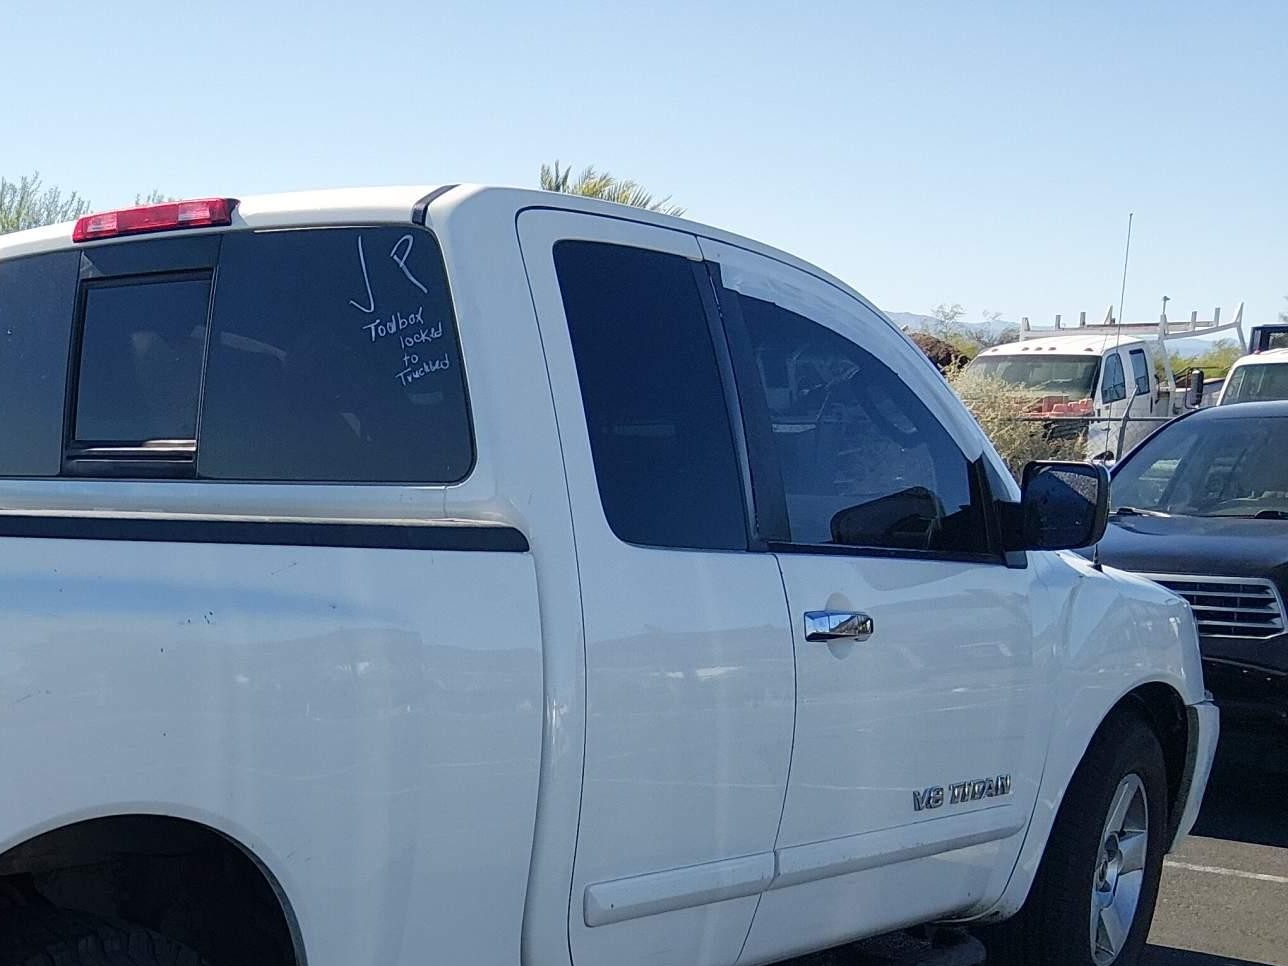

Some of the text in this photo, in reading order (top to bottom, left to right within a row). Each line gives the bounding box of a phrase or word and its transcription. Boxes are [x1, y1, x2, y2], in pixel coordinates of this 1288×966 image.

[362, 306, 424, 342] Toolbox
[399, 321, 443, 349] locked
[403, 352, 419, 367] to
